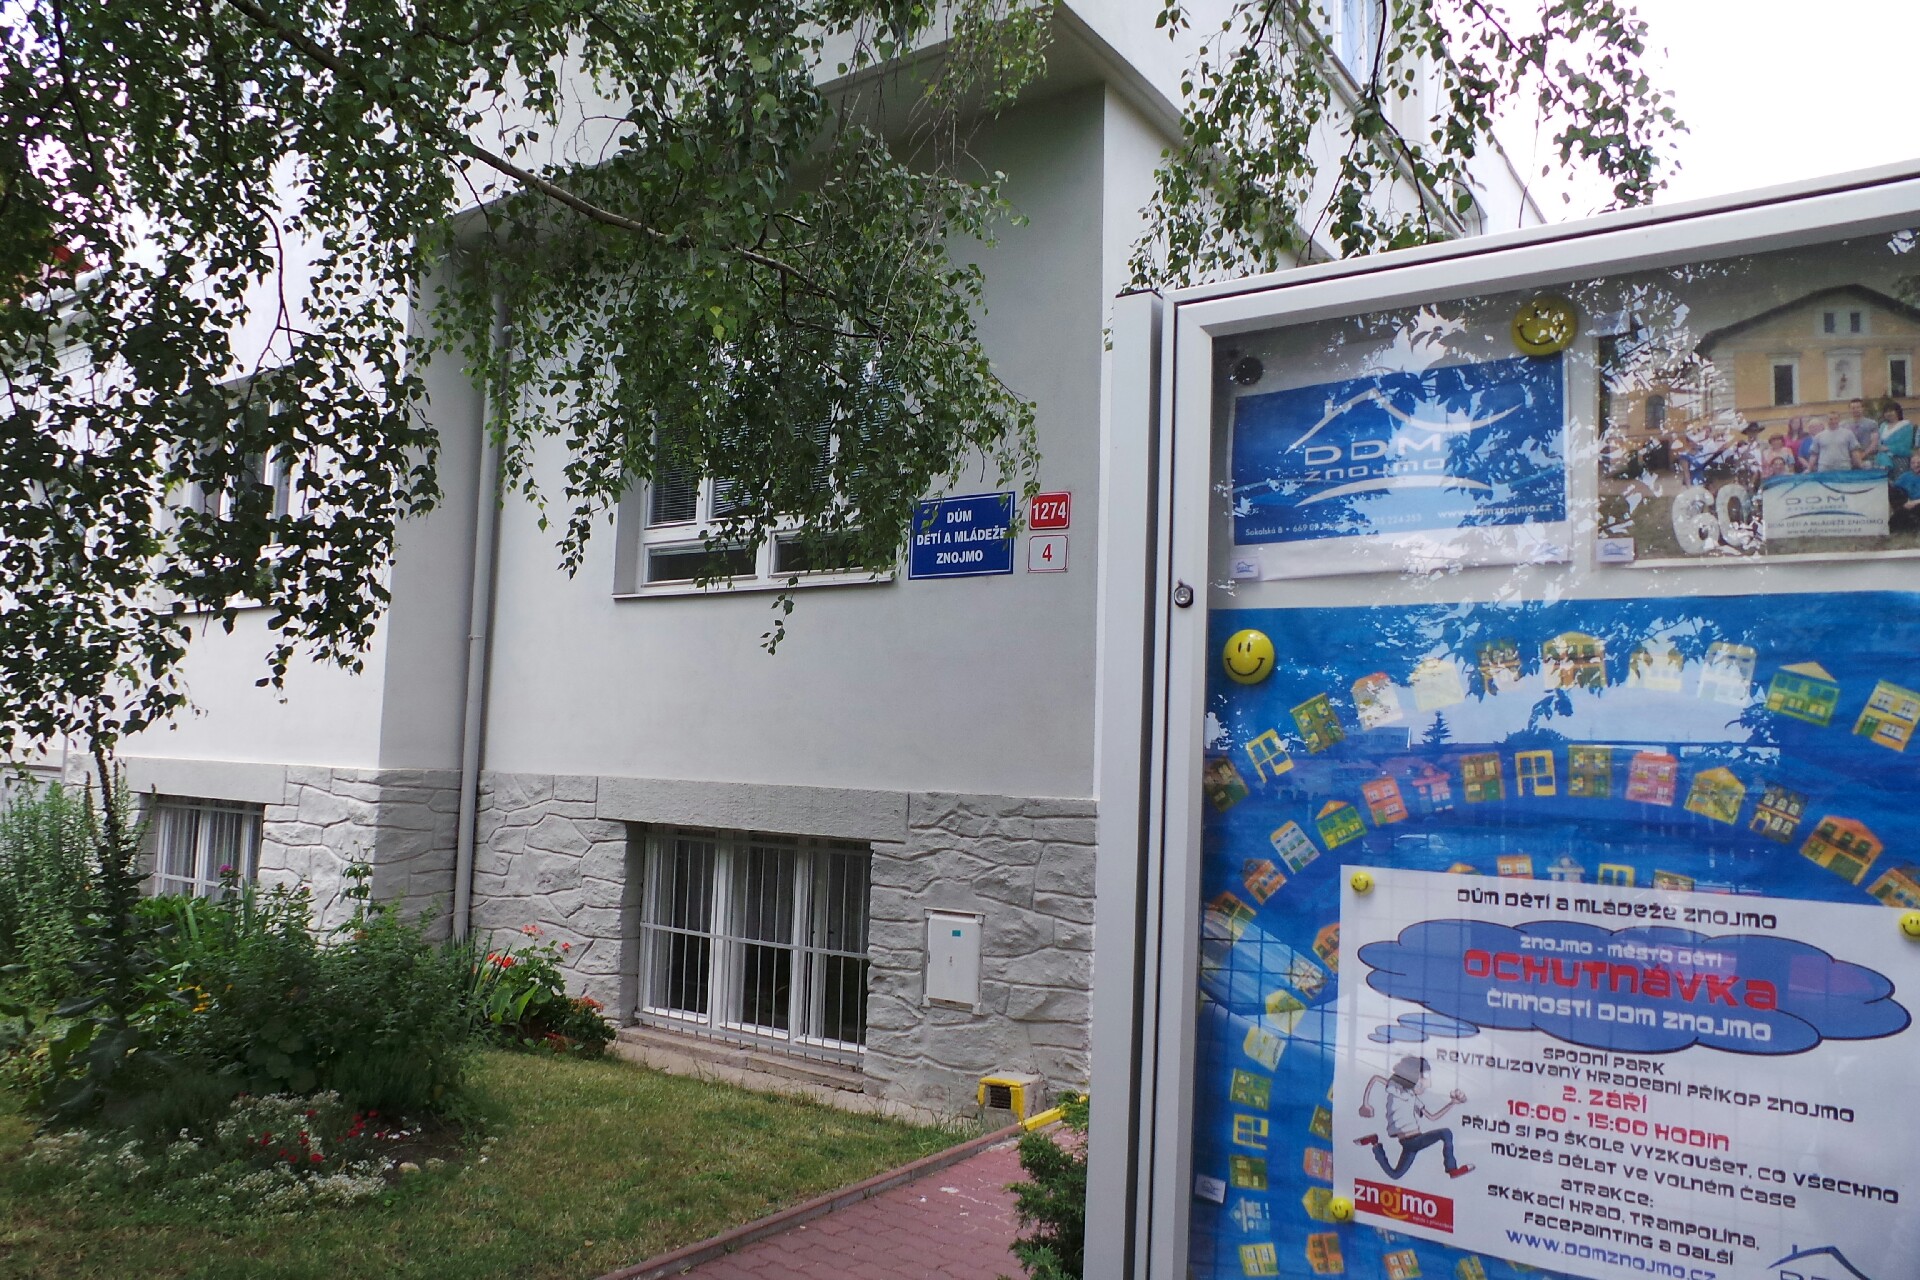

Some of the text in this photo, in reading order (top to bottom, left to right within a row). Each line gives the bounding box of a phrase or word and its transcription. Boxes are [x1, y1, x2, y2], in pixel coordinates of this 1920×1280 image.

[1305, 433, 1441, 465] DDM
[947, 508, 972, 524] DŮM
[1033, 502, 1066, 520] 1274
[917, 524, 1007, 546] DĚTÍ A MLÁDEŽE
[1245, 528, 1276, 536] Sokolská
[1278, 526, 1283, 534] 8
[1292, 524, 1307, 532] 669
[936, 549, 983, 565] ZNOJMO
[1042, 543, 1052, 562] 4
[1457, 888, 1499, 906] DŮM
[1562, 1085, 1582, 1103] 2.
[1507, 1100, 1566, 1123] 10:00
[1586, 1112, 1648, 1136] 15:00
[1516, 1125, 1530, 1138] SI
[1535, 1128, 1558, 1143] PO
[1758, 1167, 1786, 1183] CO
[1355, 1184, 1438, 1218] znojmo
